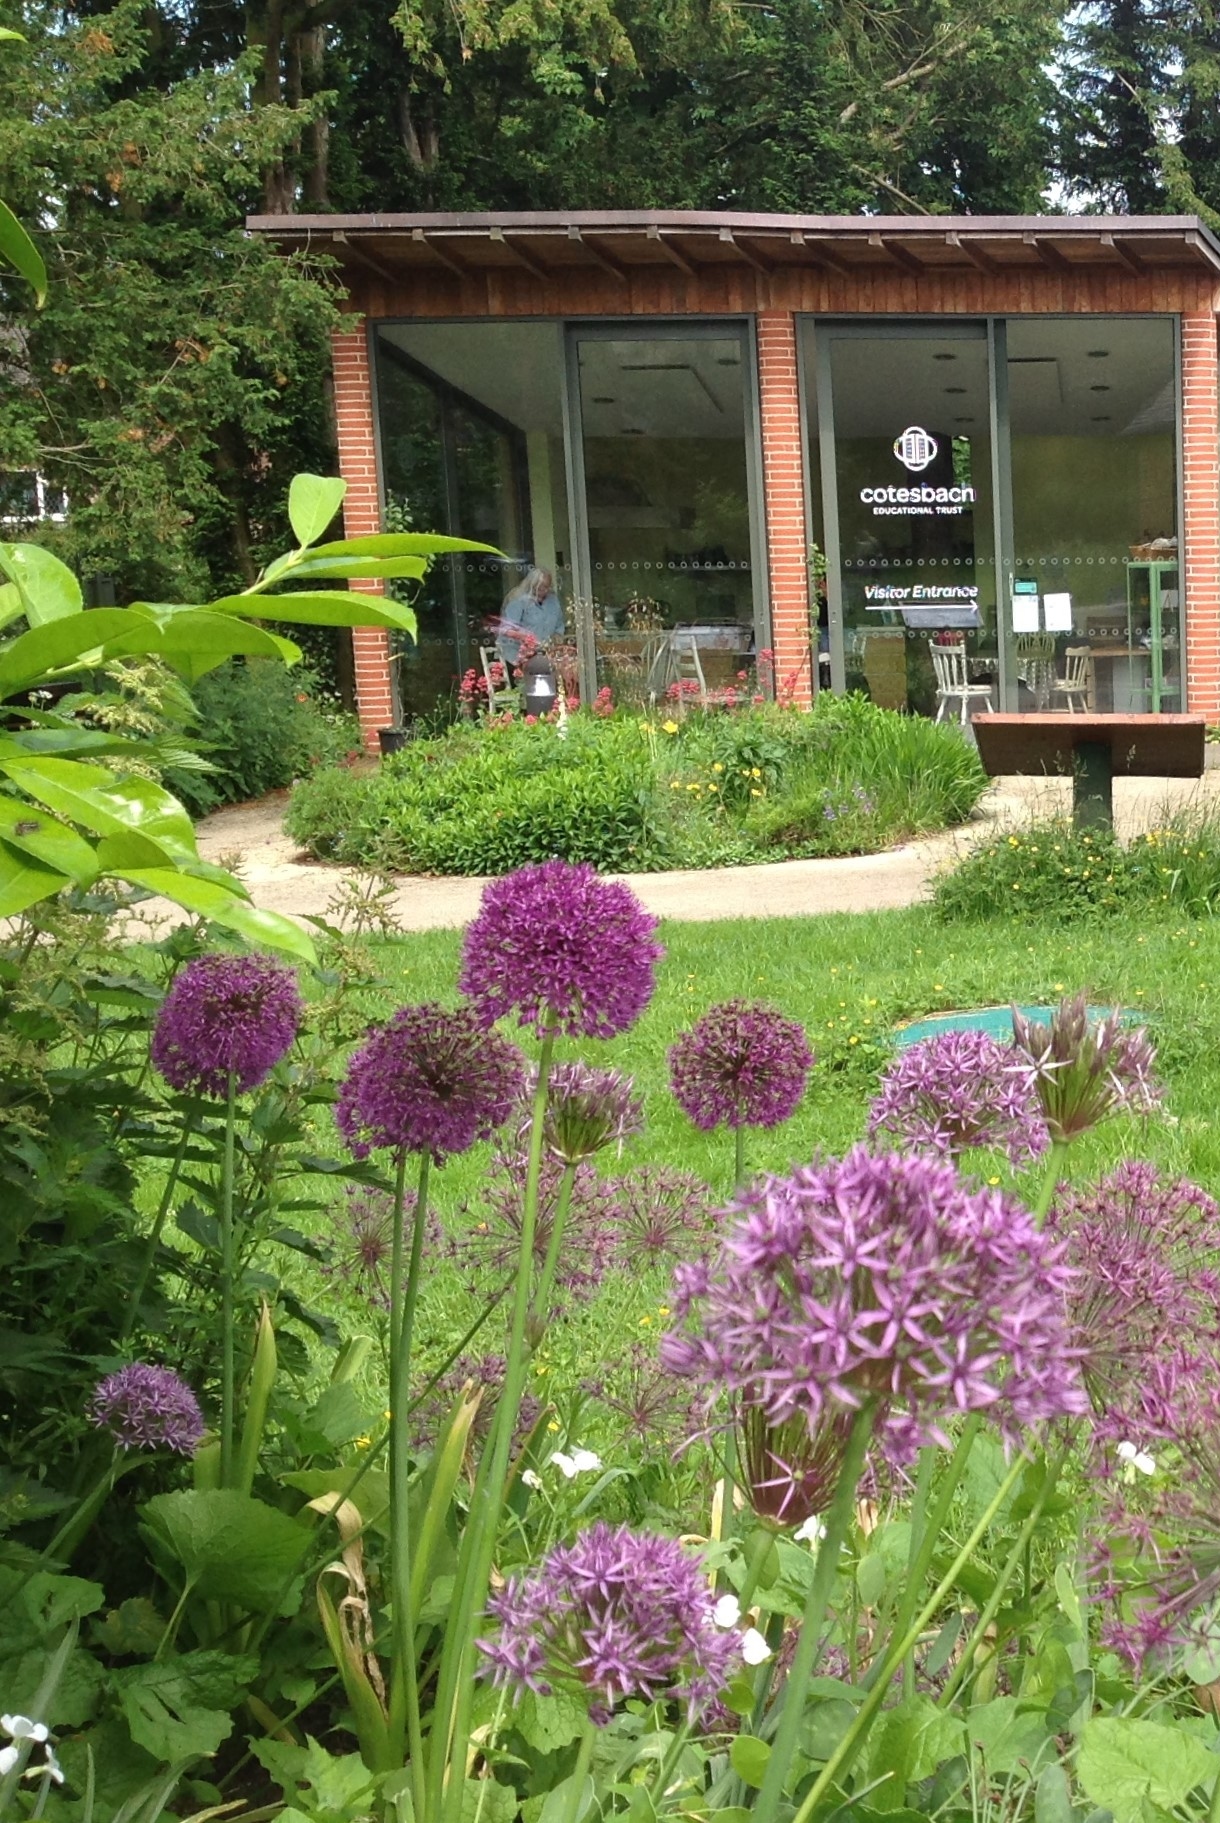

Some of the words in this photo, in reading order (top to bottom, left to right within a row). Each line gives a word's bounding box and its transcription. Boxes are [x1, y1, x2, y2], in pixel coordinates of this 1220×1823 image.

[860, 482, 976, 503] cotesbach
[873, 507, 934, 515] EDUCATIONAL
[935, 507, 963, 515] TRUST
[864, 584, 910, 599] Visitor
[912, 584, 979, 598] Entrance
